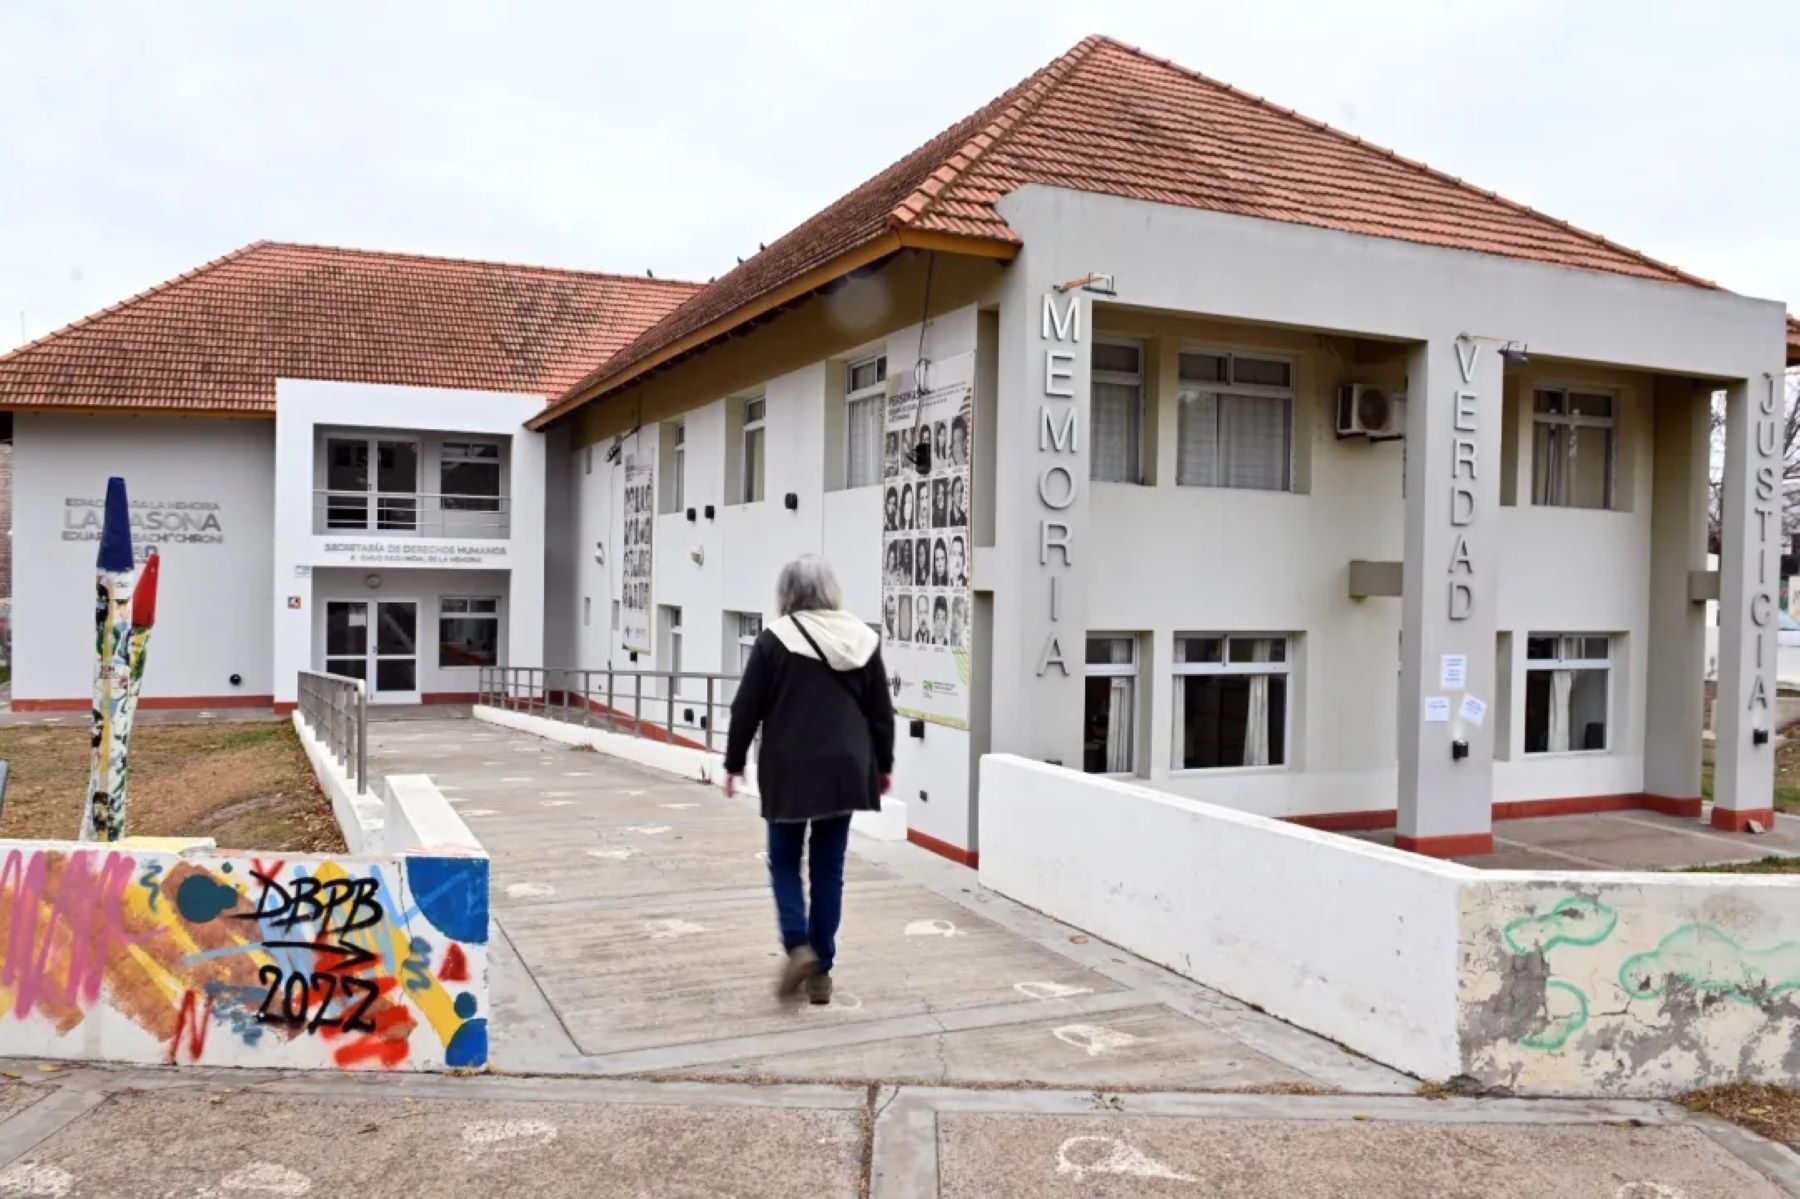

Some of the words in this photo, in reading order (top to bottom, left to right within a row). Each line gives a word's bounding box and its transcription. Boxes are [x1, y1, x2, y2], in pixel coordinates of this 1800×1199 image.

[1036, 293, 1081, 678] MEMORIA
[1446, 343, 1481, 622] VERDAD
[65, 509, 102, 529] LA
[131, 511, 221, 531] ASONA
[387, 544, 400, 552] DE
[403, 544, 454, 553] DERECHOS
[457, 546, 506, 555] HUMANOS
[1747, 373, 1777, 711] JUSTICIA
[232, 868, 384, 937] DBPB
[256, 965, 379, 1035] 2022
